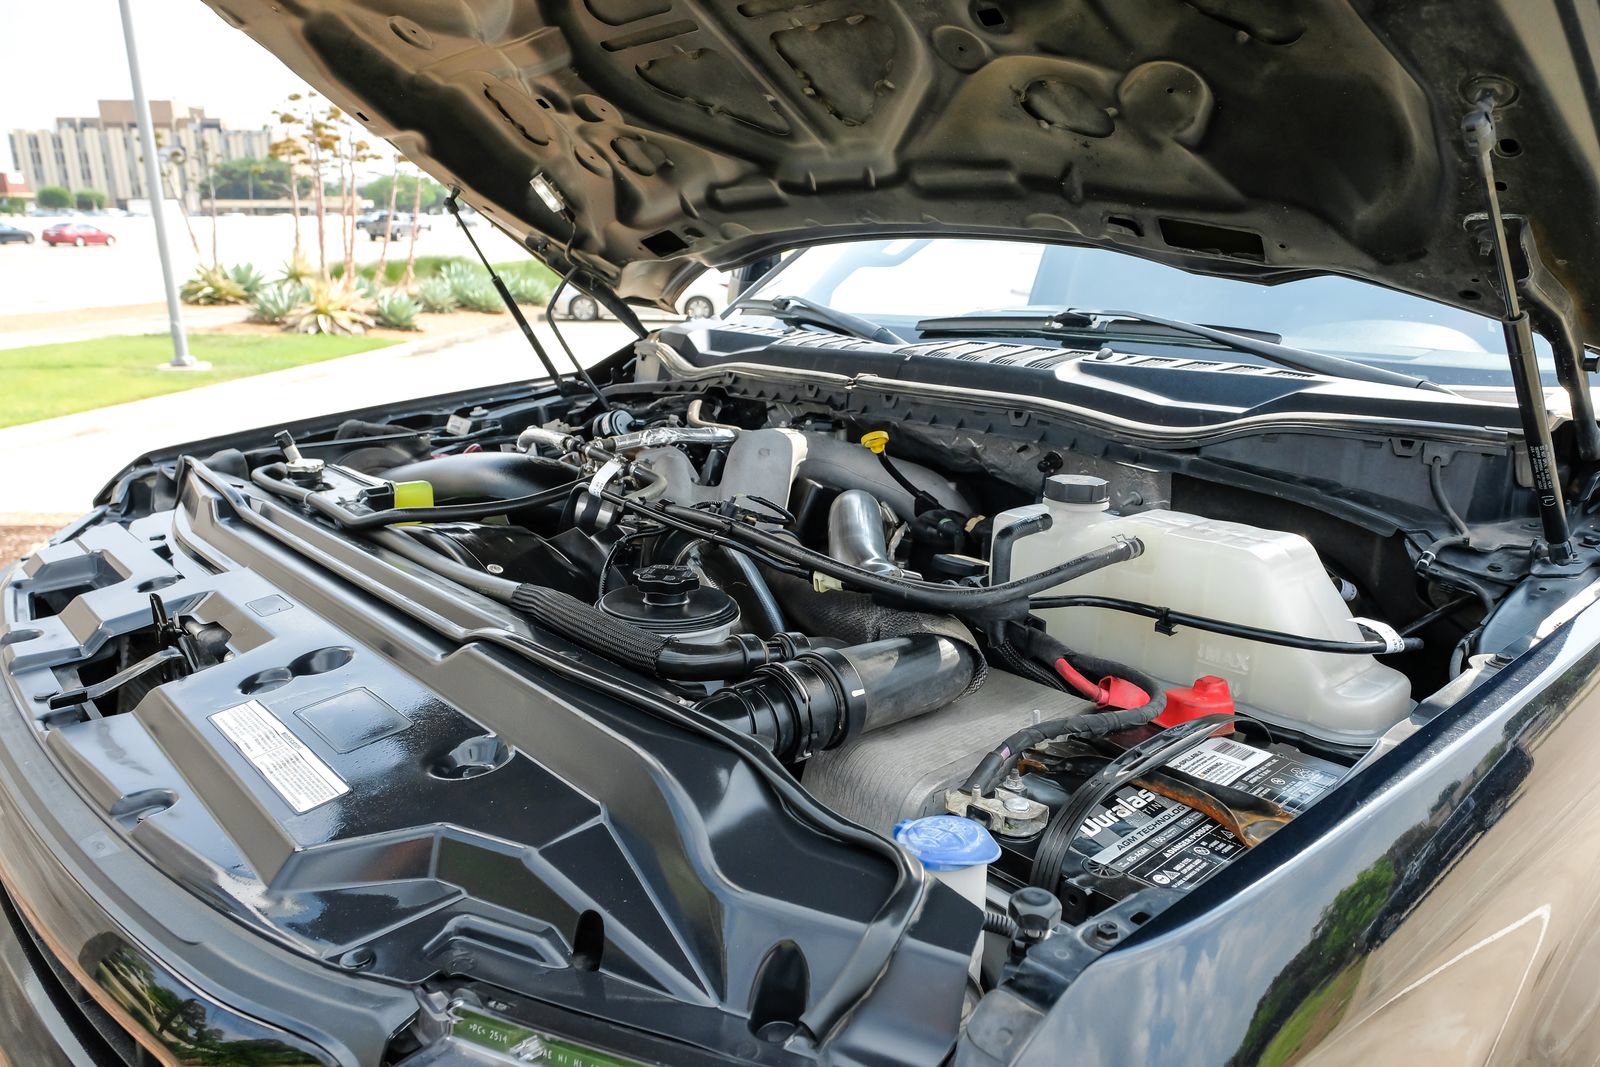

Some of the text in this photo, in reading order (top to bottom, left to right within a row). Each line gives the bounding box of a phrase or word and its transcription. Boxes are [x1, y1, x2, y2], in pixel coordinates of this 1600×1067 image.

[1079, 788, 1158, 838] Duralas
[1116, 835, 1139, 850] AGM
[1136, 804, 1186, 837] TECHNOLOG
